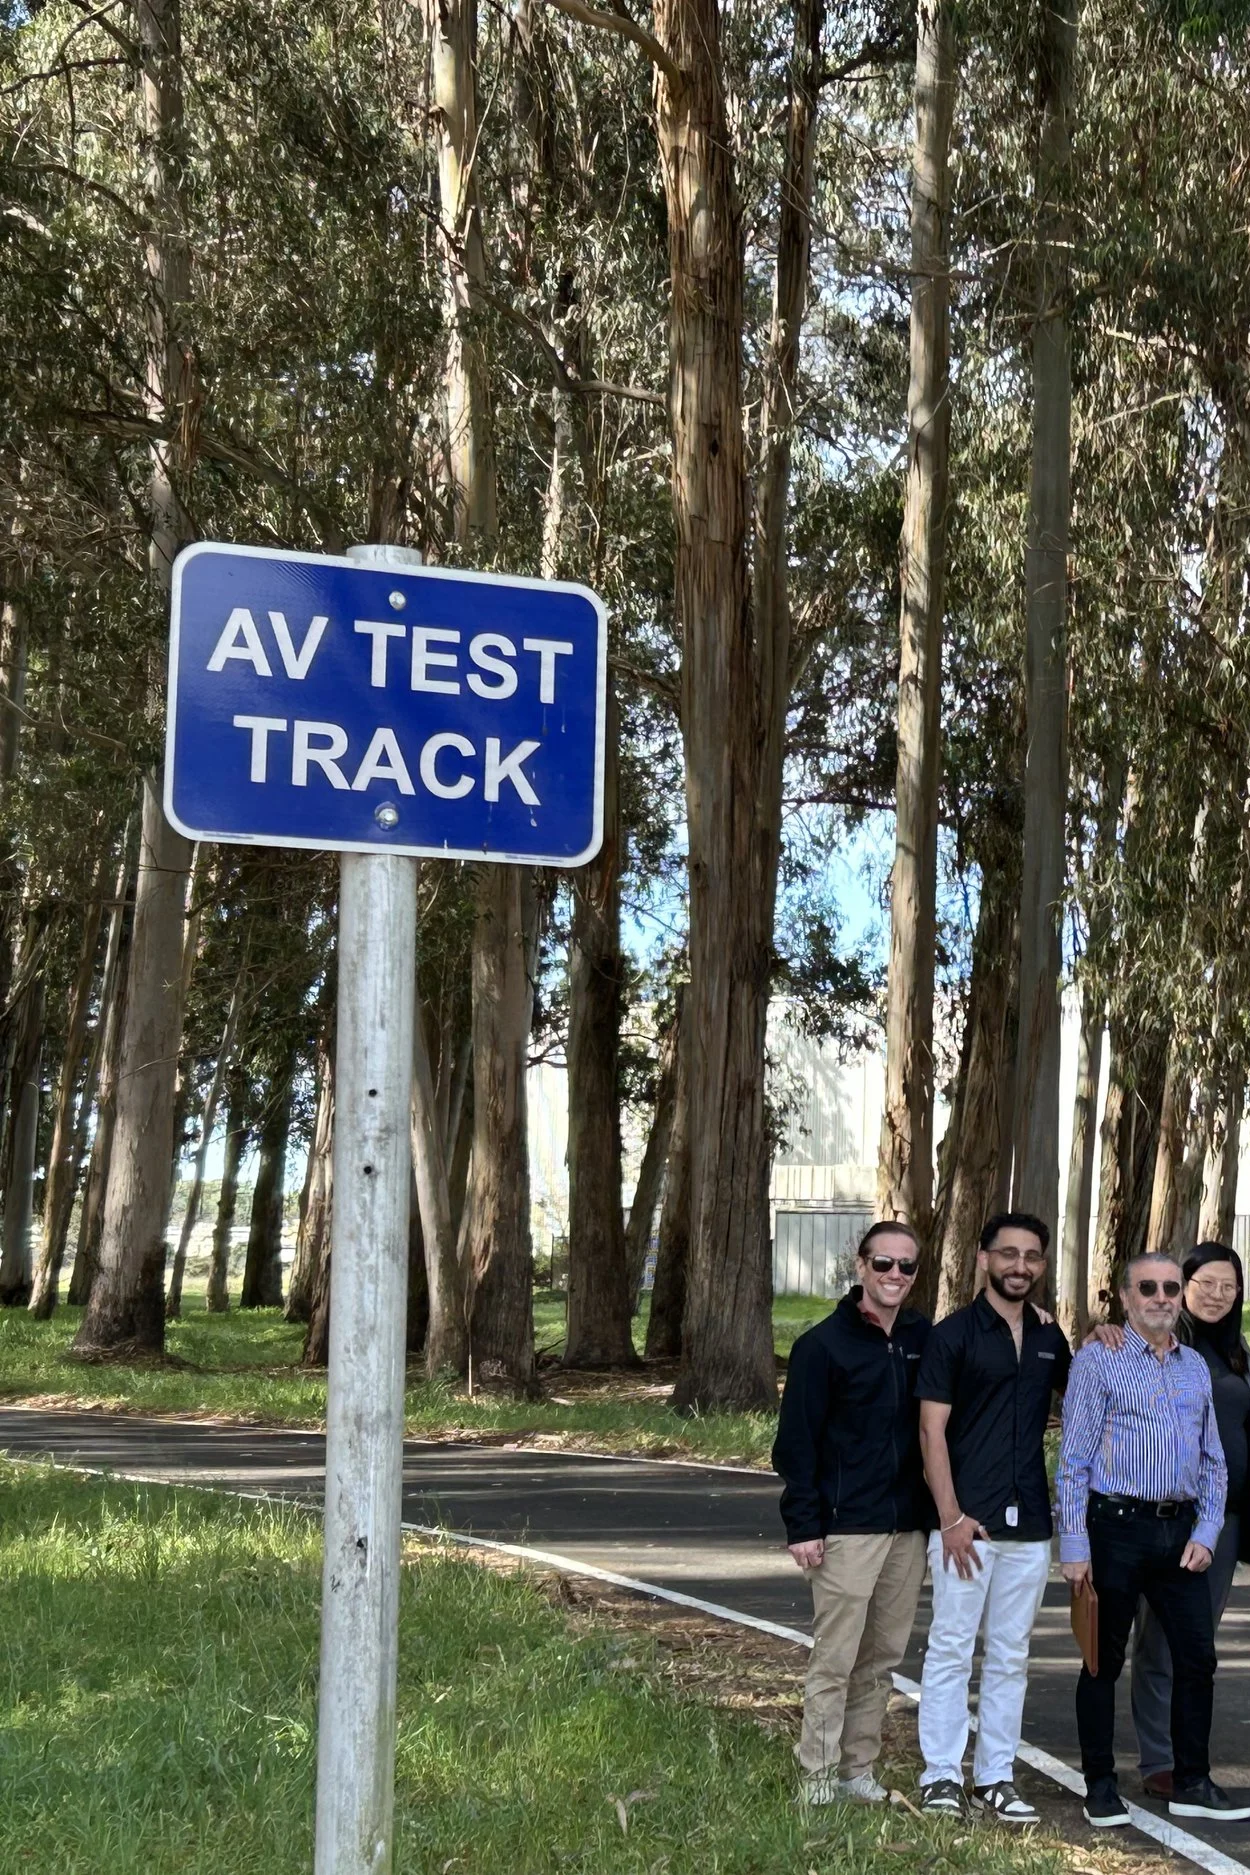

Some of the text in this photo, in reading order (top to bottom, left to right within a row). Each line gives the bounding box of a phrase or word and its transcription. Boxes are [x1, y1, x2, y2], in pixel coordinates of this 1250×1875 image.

[206, 608, 573, 704] AV TEST
[233, 715, 541, 805] TRACK
